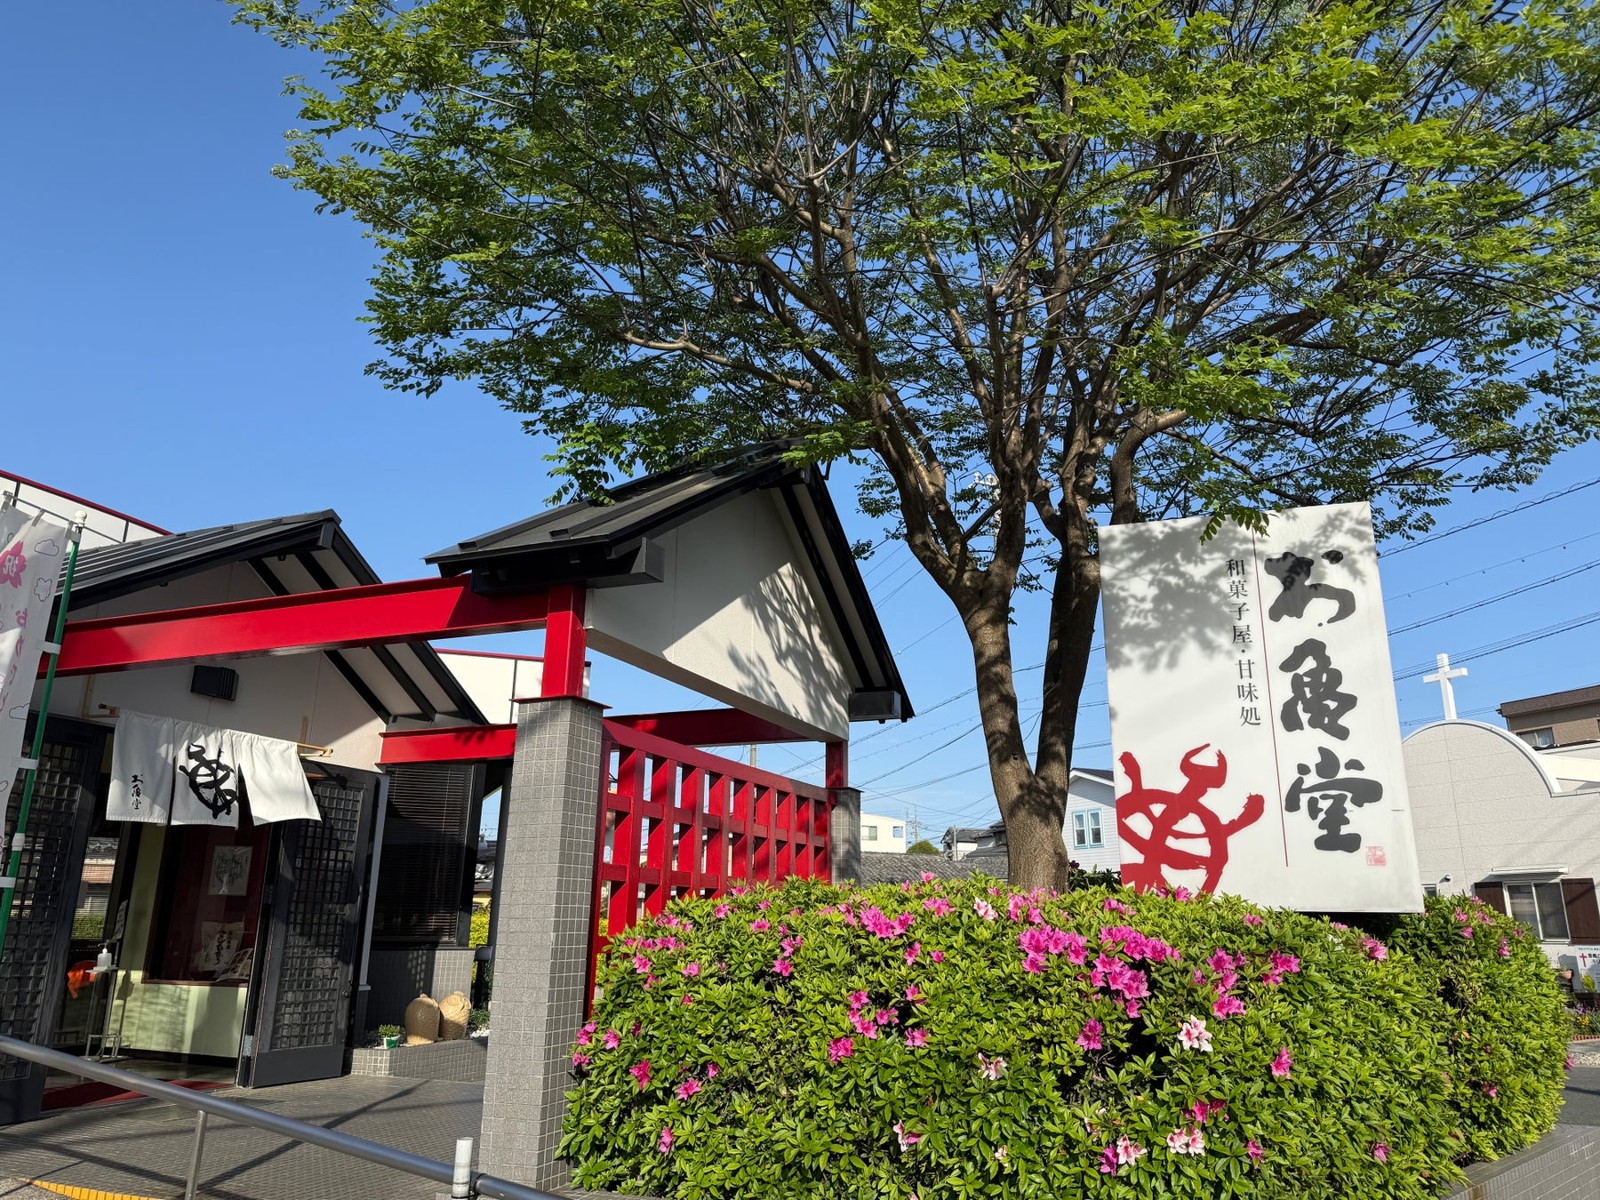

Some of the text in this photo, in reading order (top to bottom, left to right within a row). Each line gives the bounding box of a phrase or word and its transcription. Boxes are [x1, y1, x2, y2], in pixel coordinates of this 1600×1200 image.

[1225, 558, 1262, 727] 和菓子屋・甘味処
